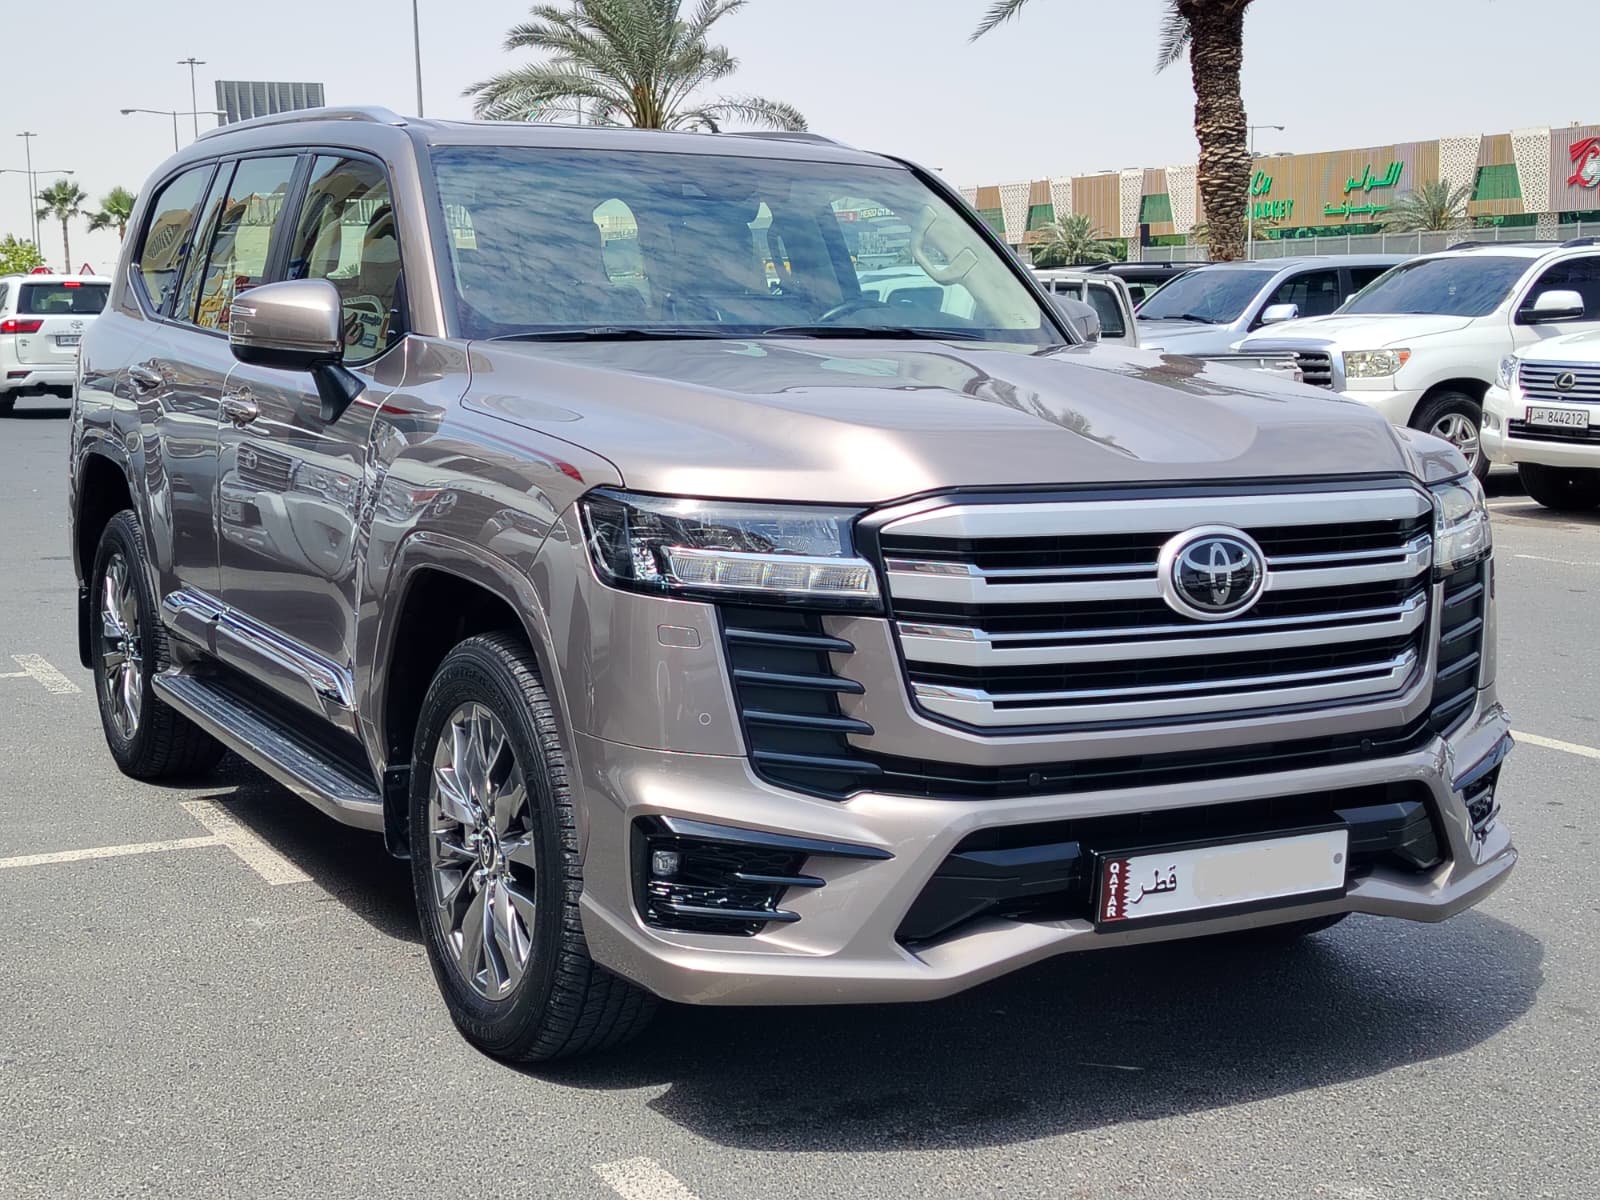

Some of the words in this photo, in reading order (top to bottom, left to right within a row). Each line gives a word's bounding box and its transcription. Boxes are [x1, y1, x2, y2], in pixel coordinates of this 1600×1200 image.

[1547, 411, 1584, 426] 844212
[1107, 862, 1120, 918] QATAR
[1128, 864, 1177, 904] قطر
